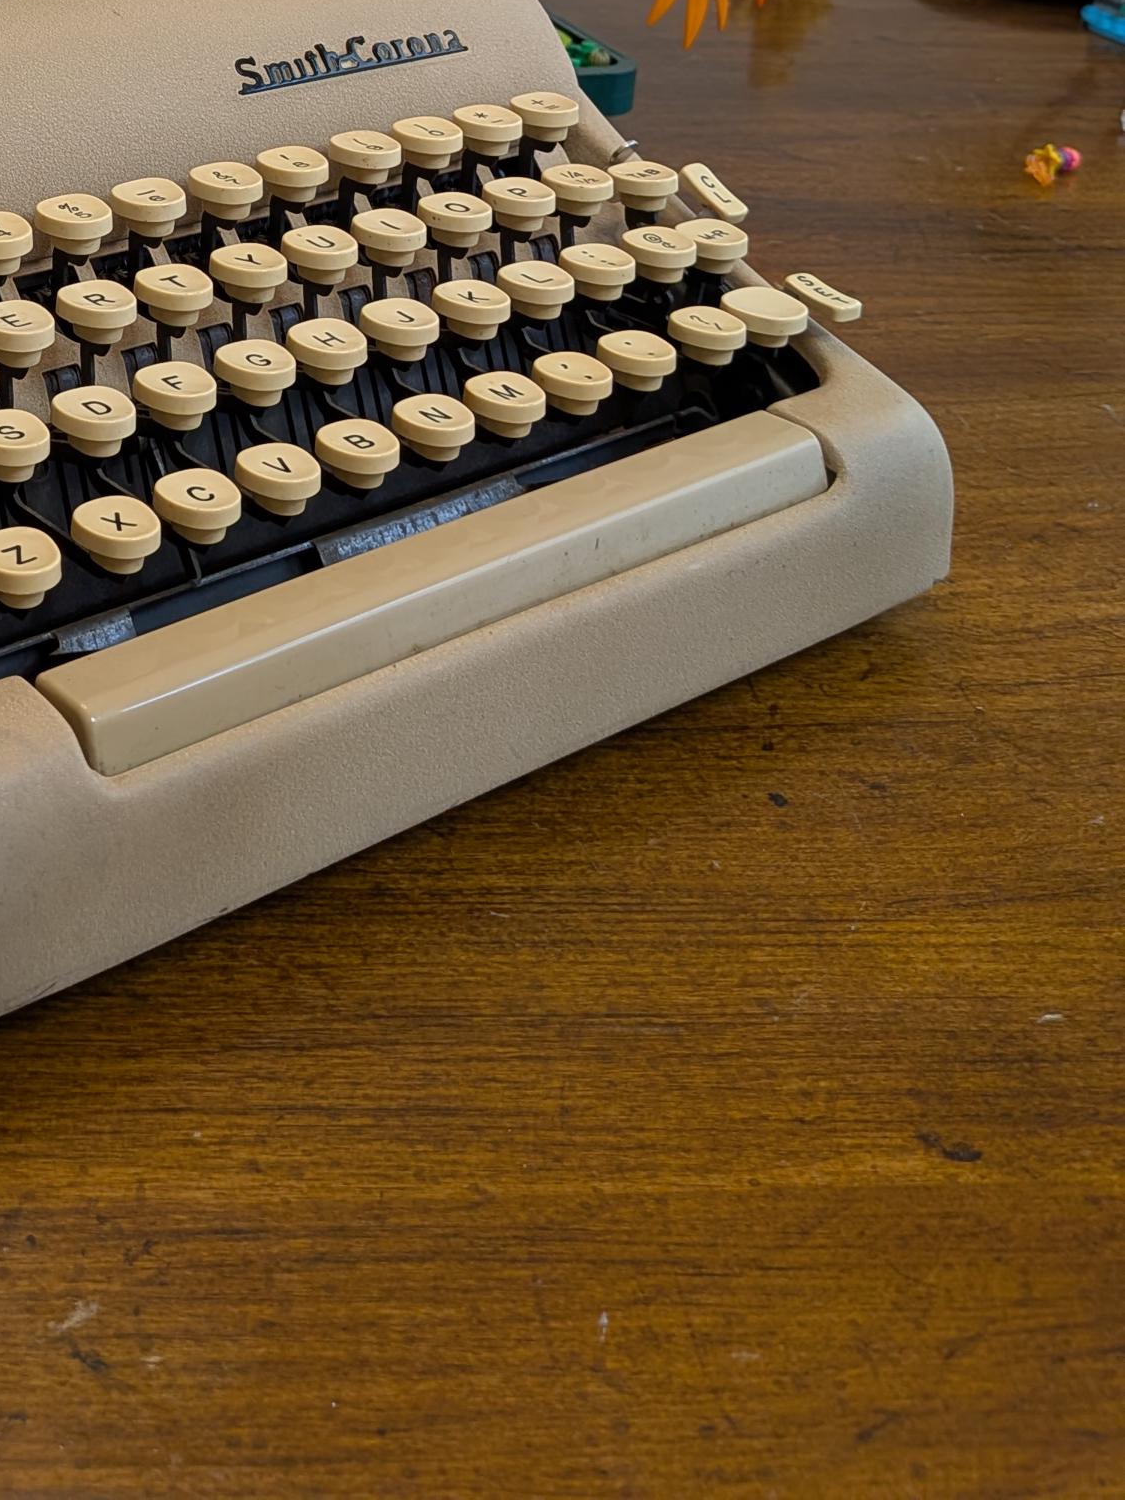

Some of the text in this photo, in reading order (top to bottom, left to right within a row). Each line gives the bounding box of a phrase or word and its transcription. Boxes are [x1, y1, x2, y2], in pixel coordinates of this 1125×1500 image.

[626, 168, 661, 181] TAB
[506, 187, 528, 198] P
[444, 202, 470, 214] O
[380, 219, 402, 231] I
[306, 235, 336, 250] U
[234, 253, 263, 267] Y
[159, 274, 188, 289] T
[520, 272, 554, 285] L
[457, 289, 491, 304] K
[796, 274, 850, 306] SET
[81, 292, 117, 307] R
[0, 312, 32, 328] E
[396, 310, 416, 324] J
[311, 330, 349, 348] H
[245, 352, 272, 367] G
[161, 374, 185, 391] F
[488, 383, 525, 401] M
[81, 400, 113, 416] D
[418, 405, 453, 424] N
[342, 433, 377, 450] B
[262, 456, 293, 475] V
[186, 485, 216, 503] C
[99, 511, 139, 532] X
[0, 543, 38, 566] Z
